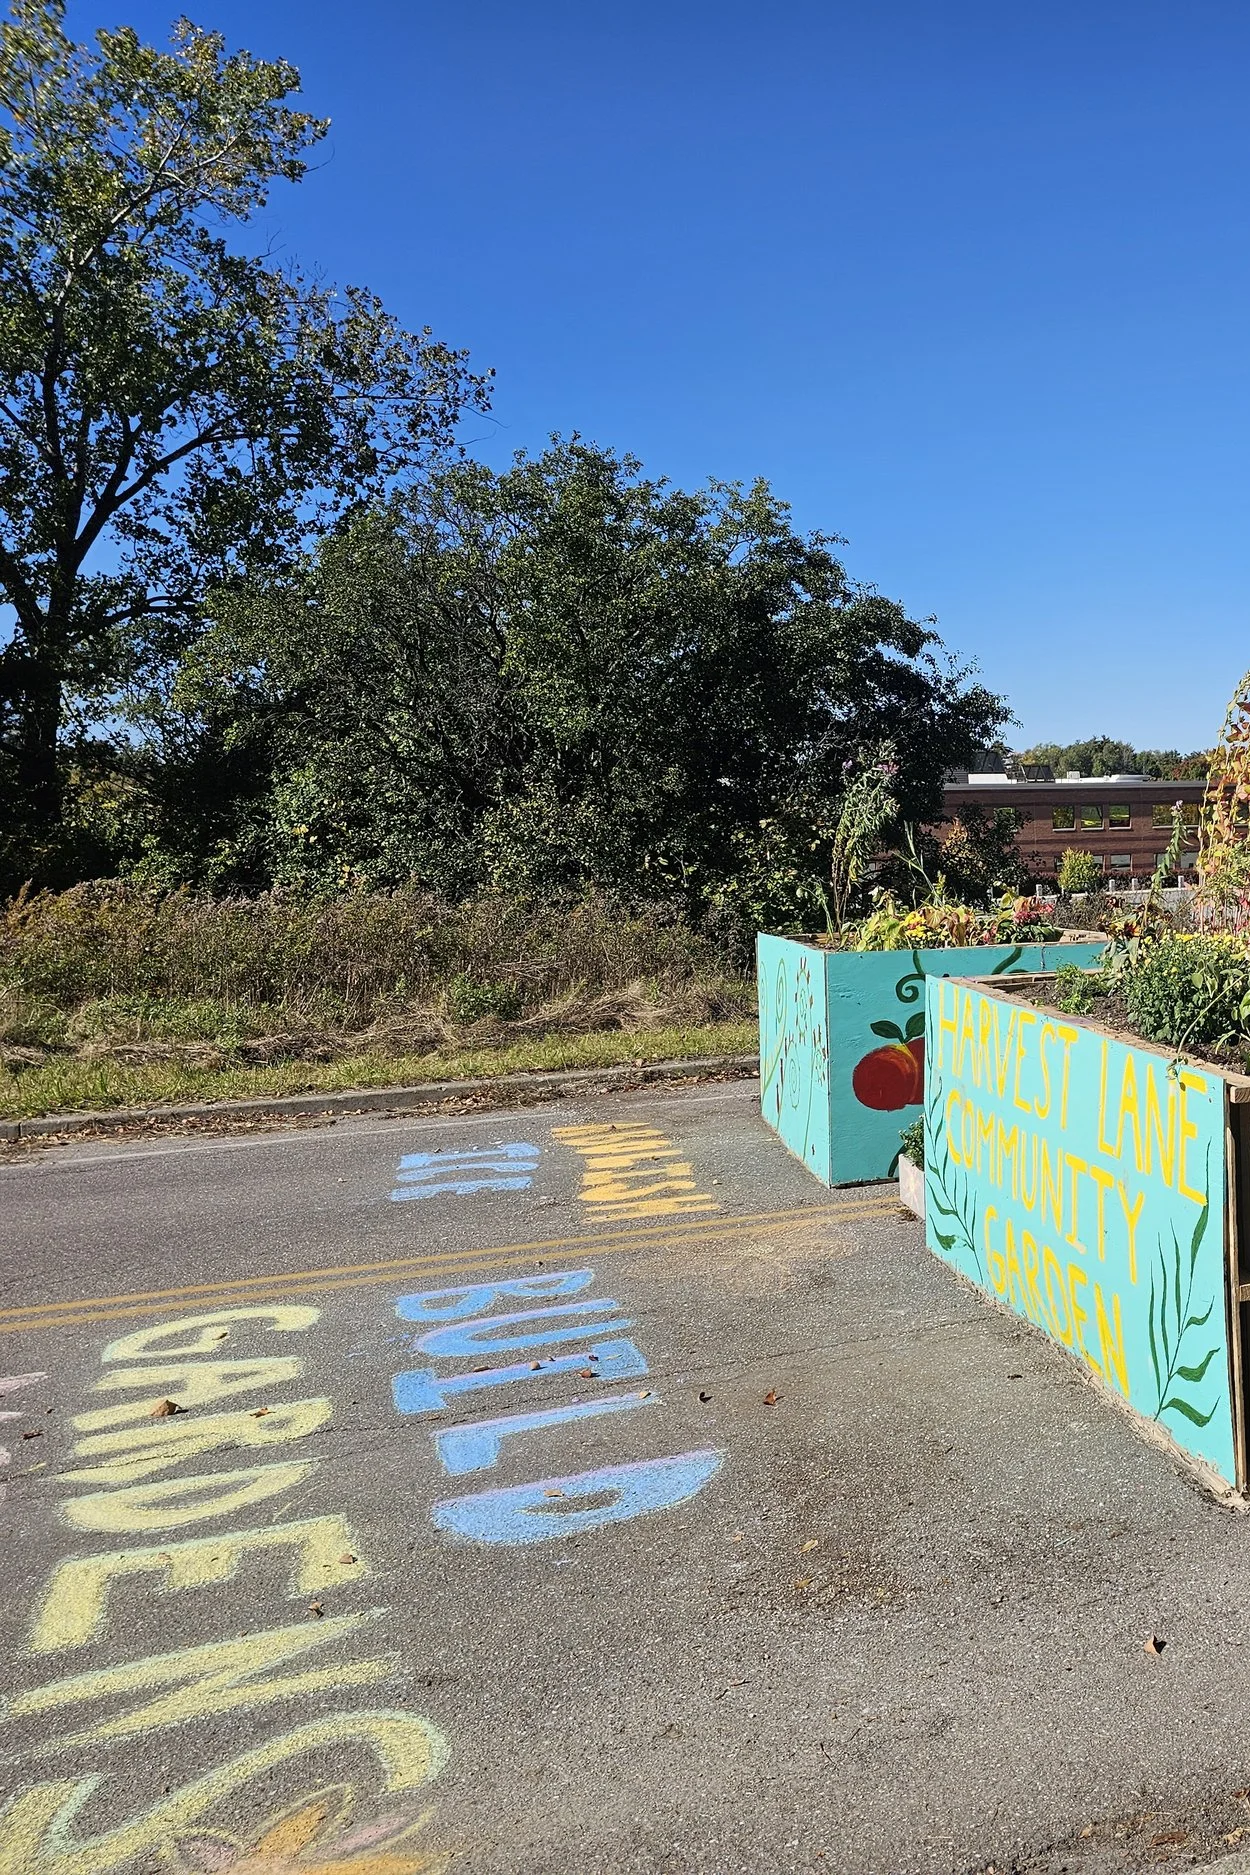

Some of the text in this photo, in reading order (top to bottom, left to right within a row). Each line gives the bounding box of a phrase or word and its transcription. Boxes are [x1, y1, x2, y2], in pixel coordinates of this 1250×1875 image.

[391, 1141, 541, 1201] ICE
[552, 1122, 721, 1223] ABOLISH
[938, 981, 1209, 1207] HARVEST LANE
[946, 1089, 1145, 1285] COMMUNITY
[983, 1206, 1130, 1398] GARDEN
[392, 1268, 726, 1547] BUILD
[0, 1305, 453, 1875] GARDENS
